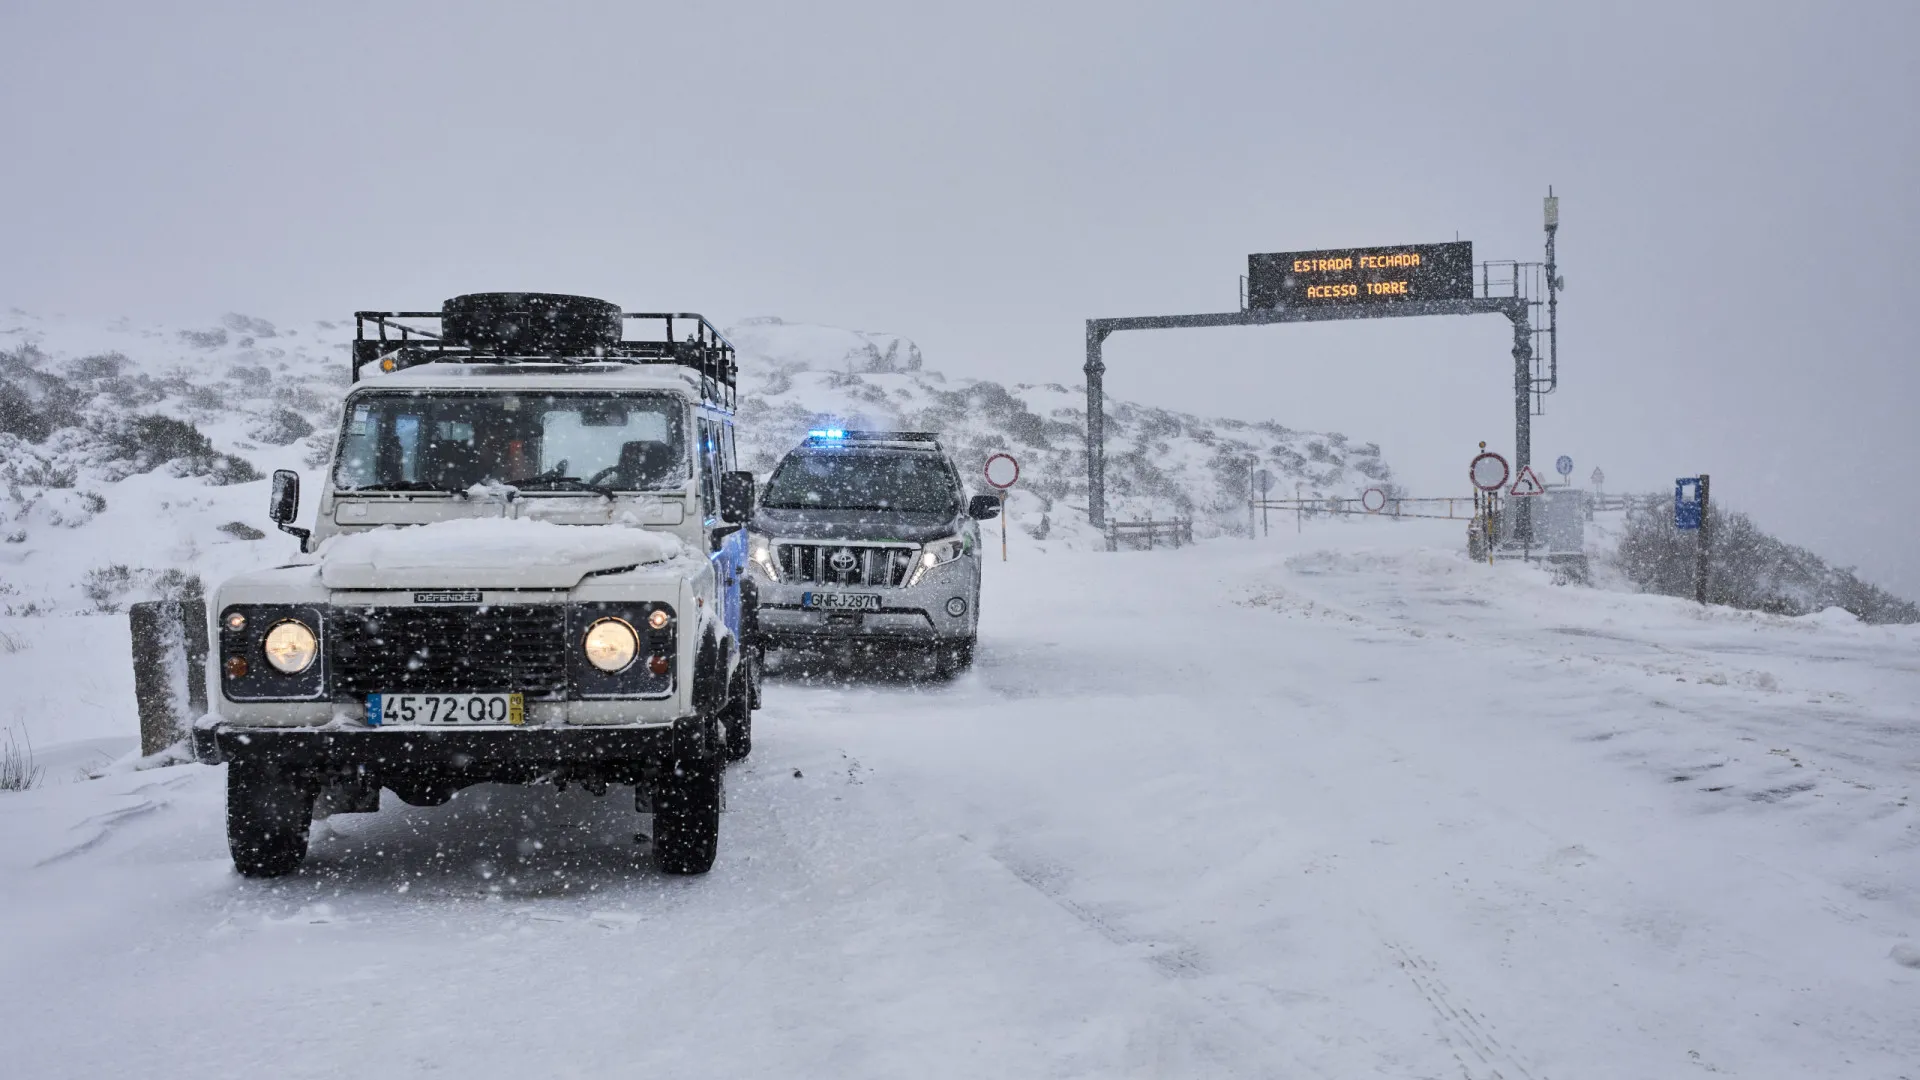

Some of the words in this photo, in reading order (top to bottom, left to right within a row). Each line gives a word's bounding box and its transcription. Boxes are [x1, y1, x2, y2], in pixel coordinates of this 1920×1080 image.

[1294, 258, 1352, 273] ESTRADA
[1360, 254, 1420, 269] FECHADA
[1307, 285, 1357, 298] ACESSO
[1366, 282, 1408, 294] TORRE
[417, 594, 478, 602] DEFENDER
